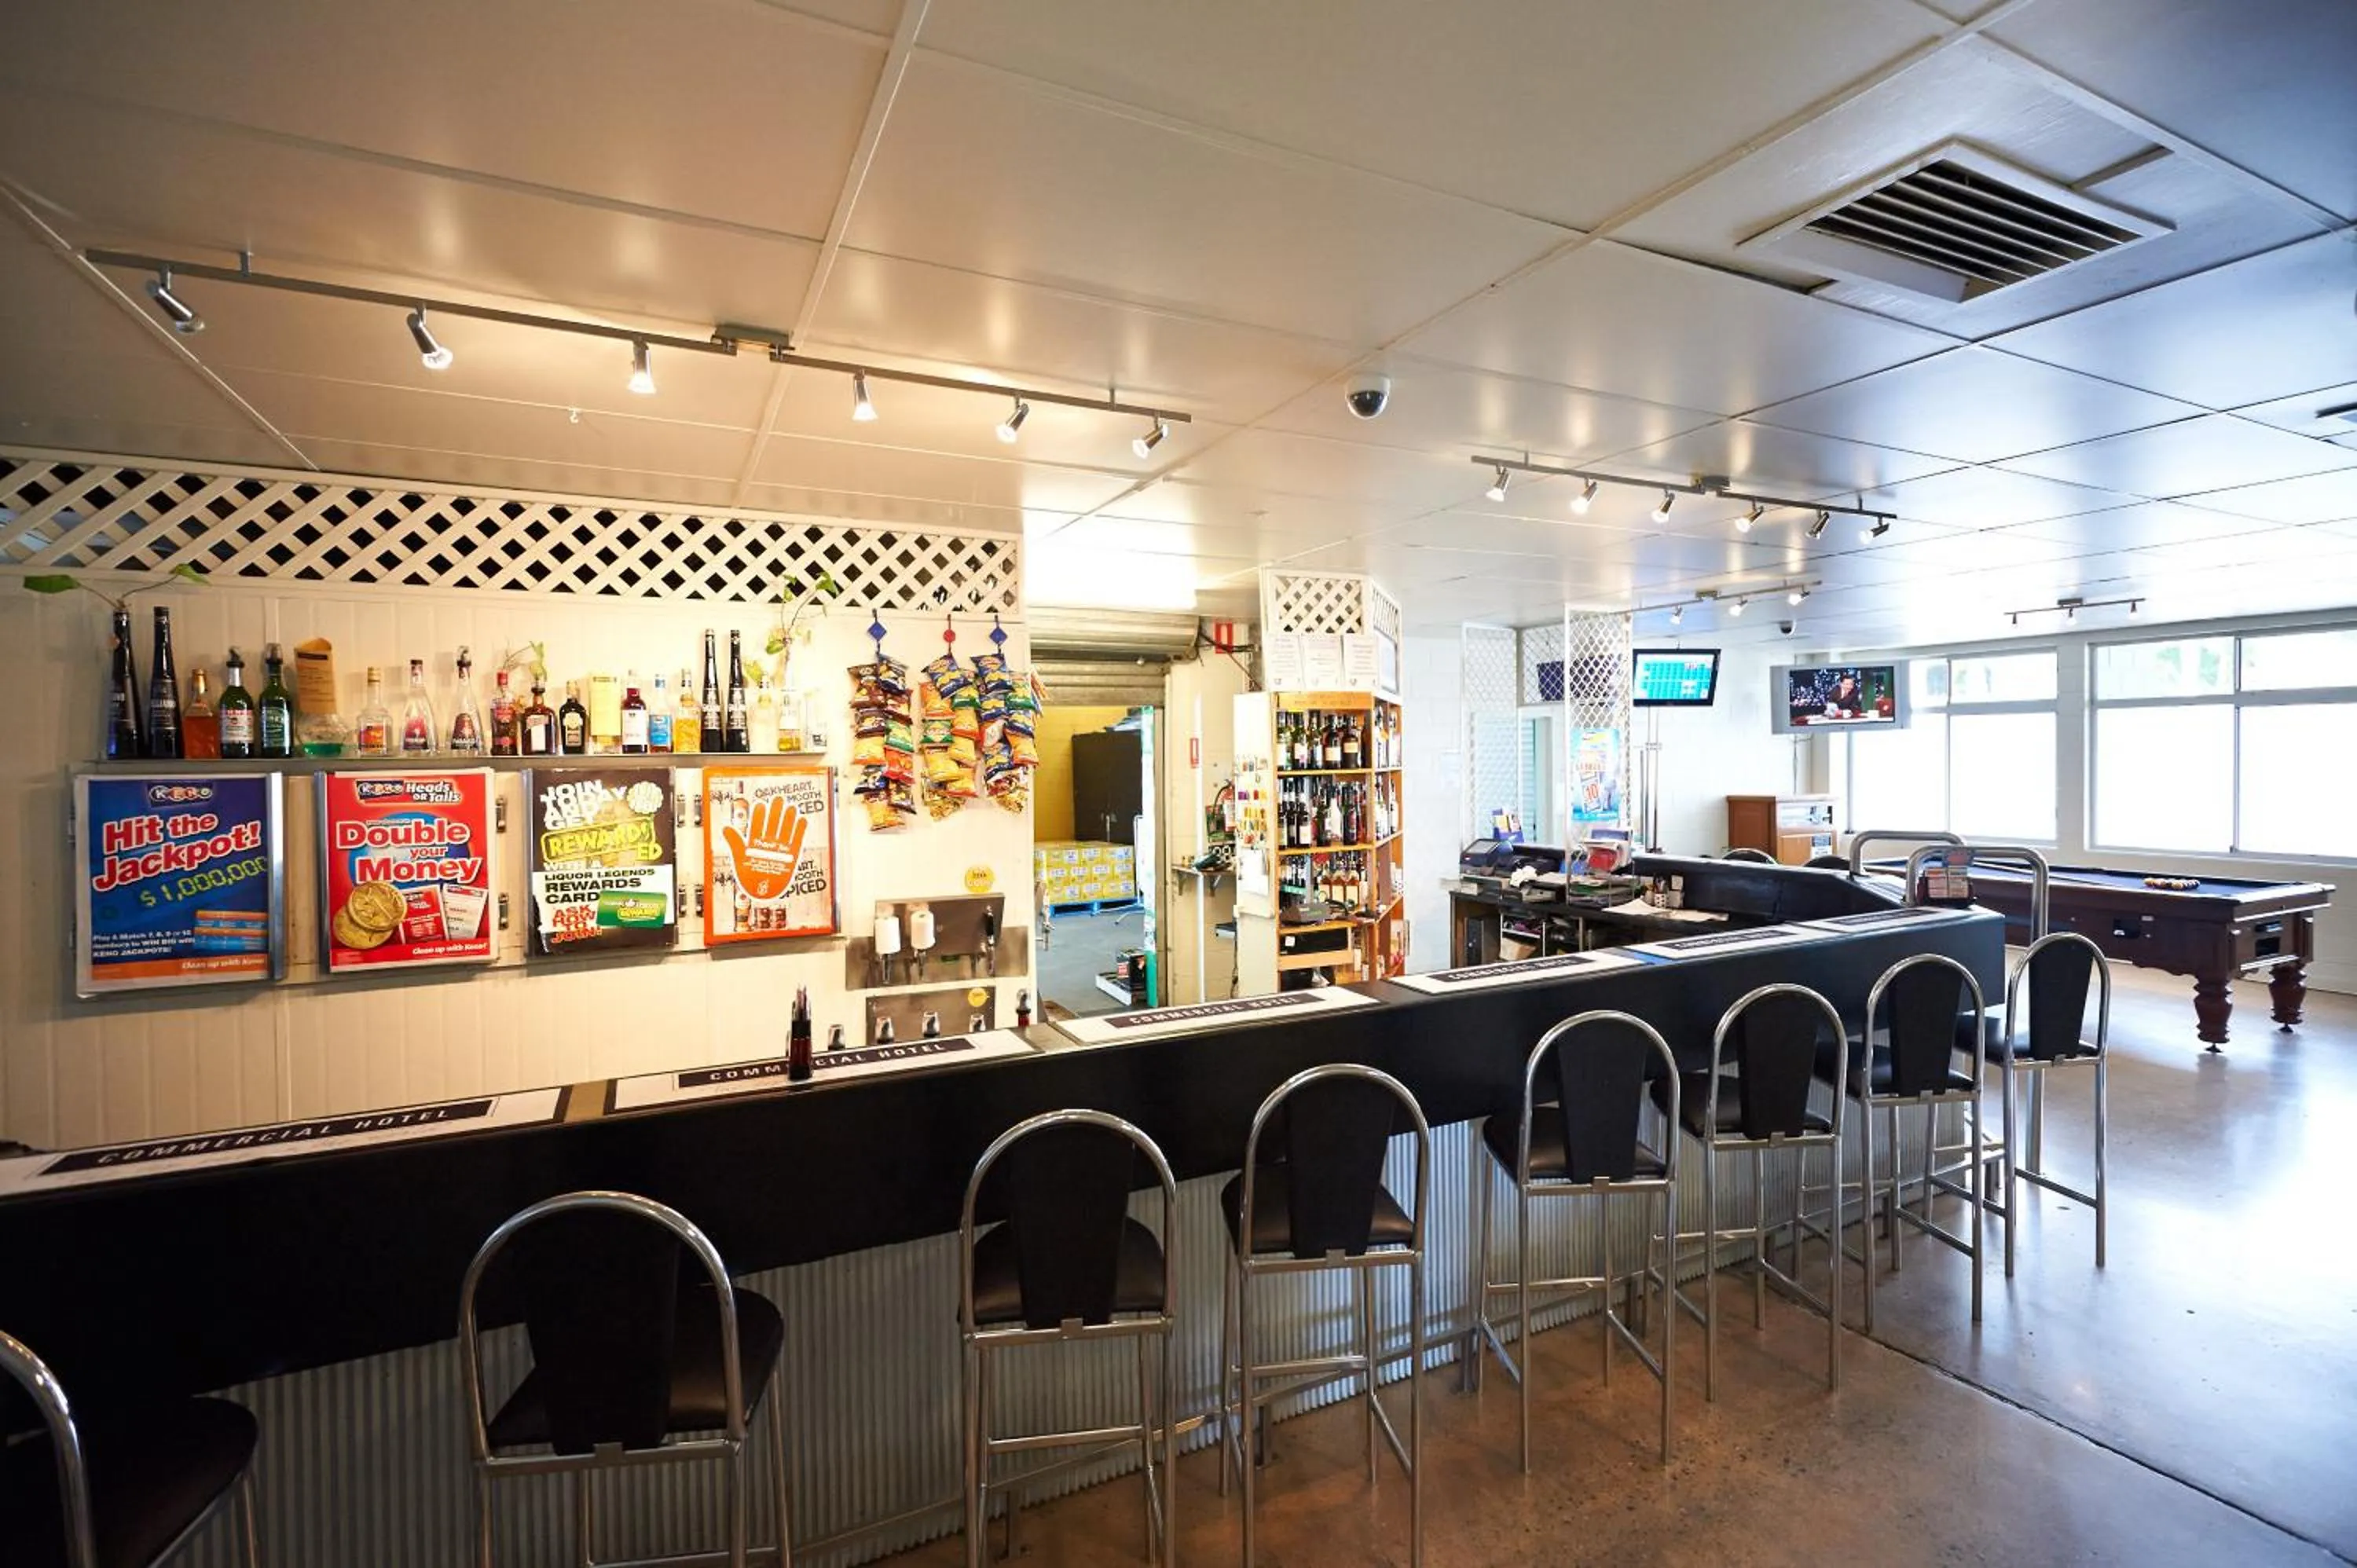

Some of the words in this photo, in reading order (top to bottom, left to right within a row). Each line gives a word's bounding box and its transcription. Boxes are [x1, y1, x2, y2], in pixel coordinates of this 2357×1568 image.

[405, 780, 450, 793] Heads
[428, 790, 461, 802] Tails
[104, 815, 164, 855] Hit
[167, 814, 219, 838] the
[336, 818, 471, 849] Double
[92, 820, 261, 892] Jackpot!
[409, 846, 448, 861] your
[356, 856, 483, 884] Money
[544, 871, 593, 881] LIQUOR
[597, 868, 655, 878] LEGENDS
[545, 878, 642, 893] REWARDS
[545, 892, 600, 903] CARD
[1129, 1004, 1244, 1024] COMMERCIAL
[1248, 996, 1301, 1009] HOTEL
[709, 1053, 863, 1080] COMMCIAL
[878, 1043, 945, 1059] HOTEL
[97, 1125, 331, 1163] COMMERCIAL
[354, 1110, 449, 1129] HOTEL
